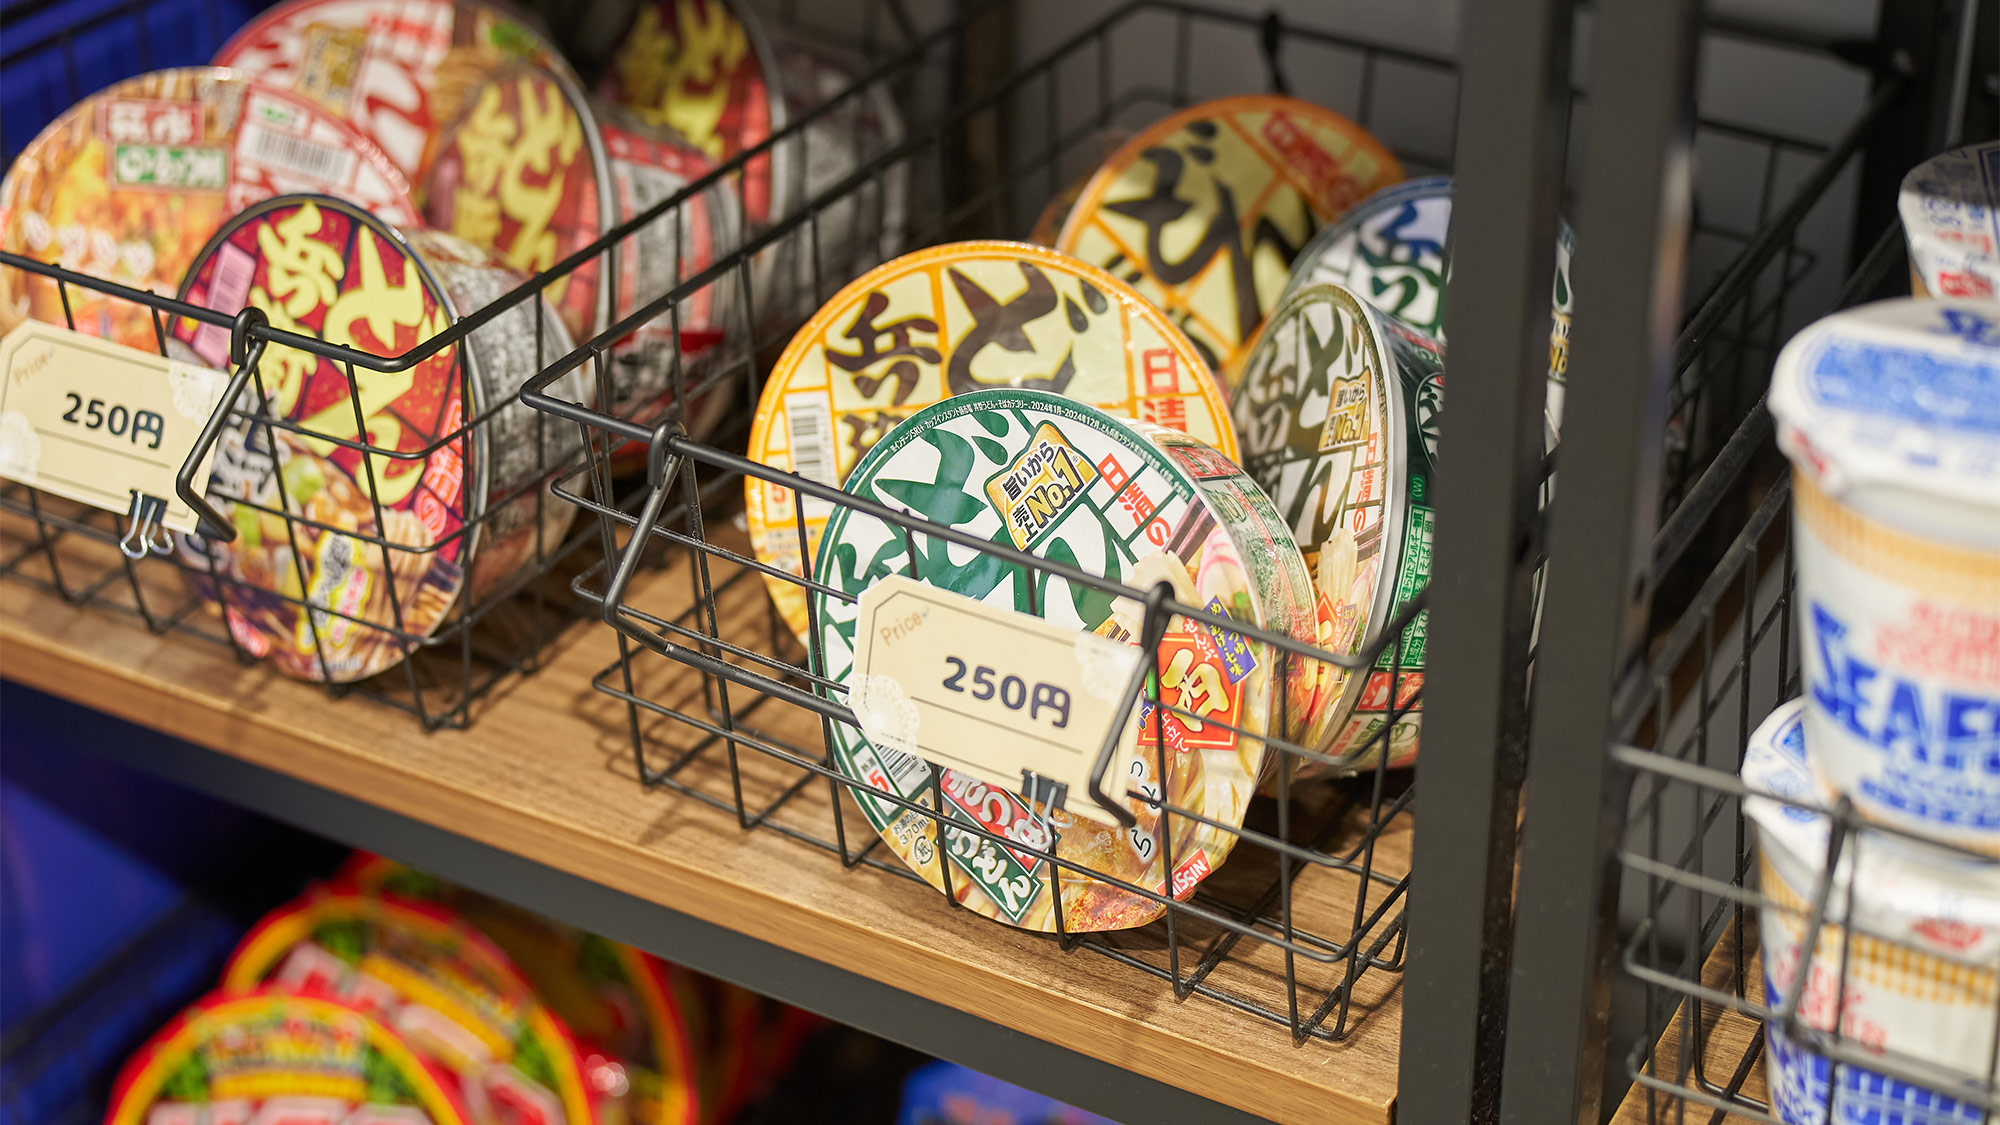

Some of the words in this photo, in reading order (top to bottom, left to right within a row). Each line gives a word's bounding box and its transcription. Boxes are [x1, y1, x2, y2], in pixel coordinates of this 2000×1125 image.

[62, 392, 164, 449] 250円
[1002, 442, 1055, 502] 旨いから
[1012, 504, 1038, 543] 売上
[1025, 446, 1085, 529] No.1
[1097, 453, 1171, 547] 日清の
[880, 612, 923, 647] Price
[942, 656, 1071, 728] 250円
